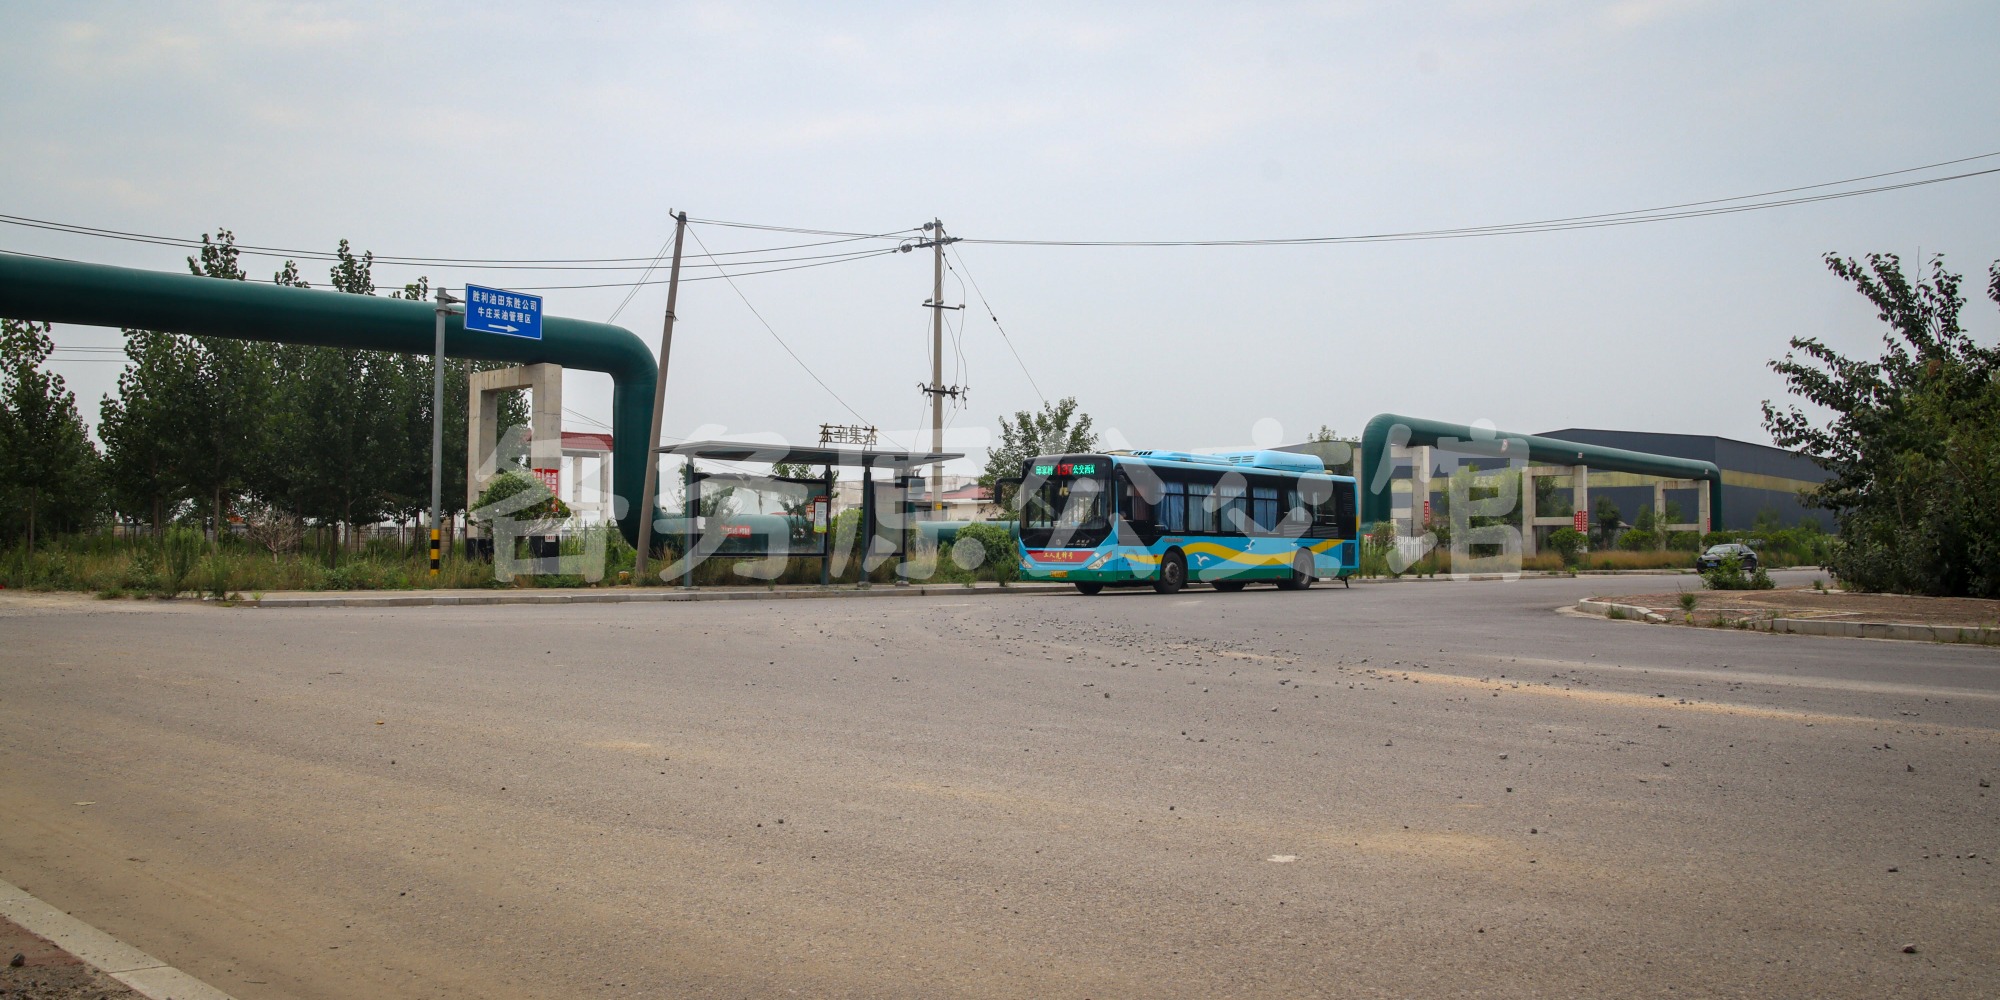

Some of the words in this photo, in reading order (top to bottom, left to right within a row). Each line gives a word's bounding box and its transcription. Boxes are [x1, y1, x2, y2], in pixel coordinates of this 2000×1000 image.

[472, 290, 537, 312] 胜利油田东胜公司
[477, 306, 532, 324] 牛庄采油管理区
